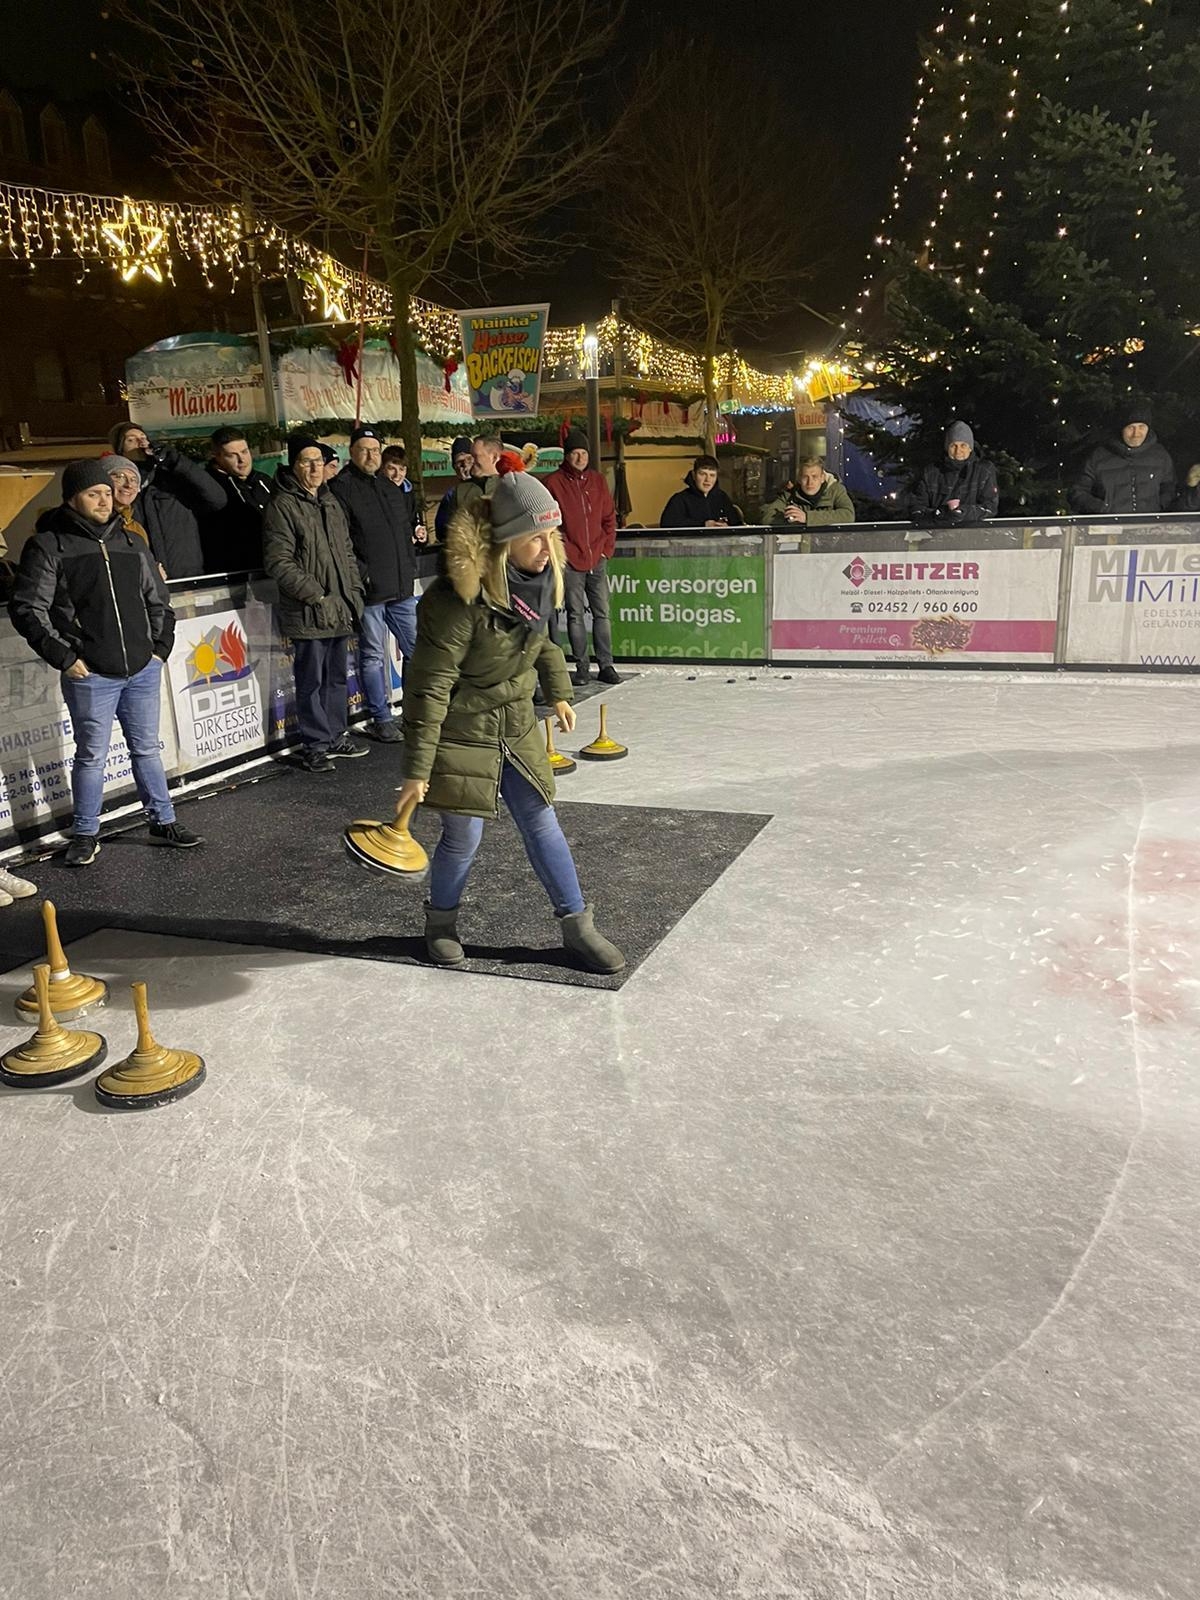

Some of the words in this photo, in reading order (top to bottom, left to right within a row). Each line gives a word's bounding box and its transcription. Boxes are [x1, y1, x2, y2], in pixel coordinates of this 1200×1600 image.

[467, 346, 540, 390] BACKFISCH
[168, 386, 239, 416] Mainka
[872, 562, 980, 580] HEITZER
[606, 575, 641, 594] Wir
[646, 579, 757, 598] versorgen
[620, 604, 654, 622] mit
[660, 604, 741, 627] Biogas.
[868, 601, 908, 613] 02452
[923, 602, 948, 613] 960
[952, 602, 978, 613] 600
[839, 624, 887, 634] Premium
[852, 633, 887, 645] Pellets
[191, 680, 255, 721] DEH
[193, 715, 223, 740] DIRK
[225, 705, 259, 730] ESSER
[195, 724, 261, 757] HAUSTECHNIK
[19, 756, 75, 781] Heinsberg
